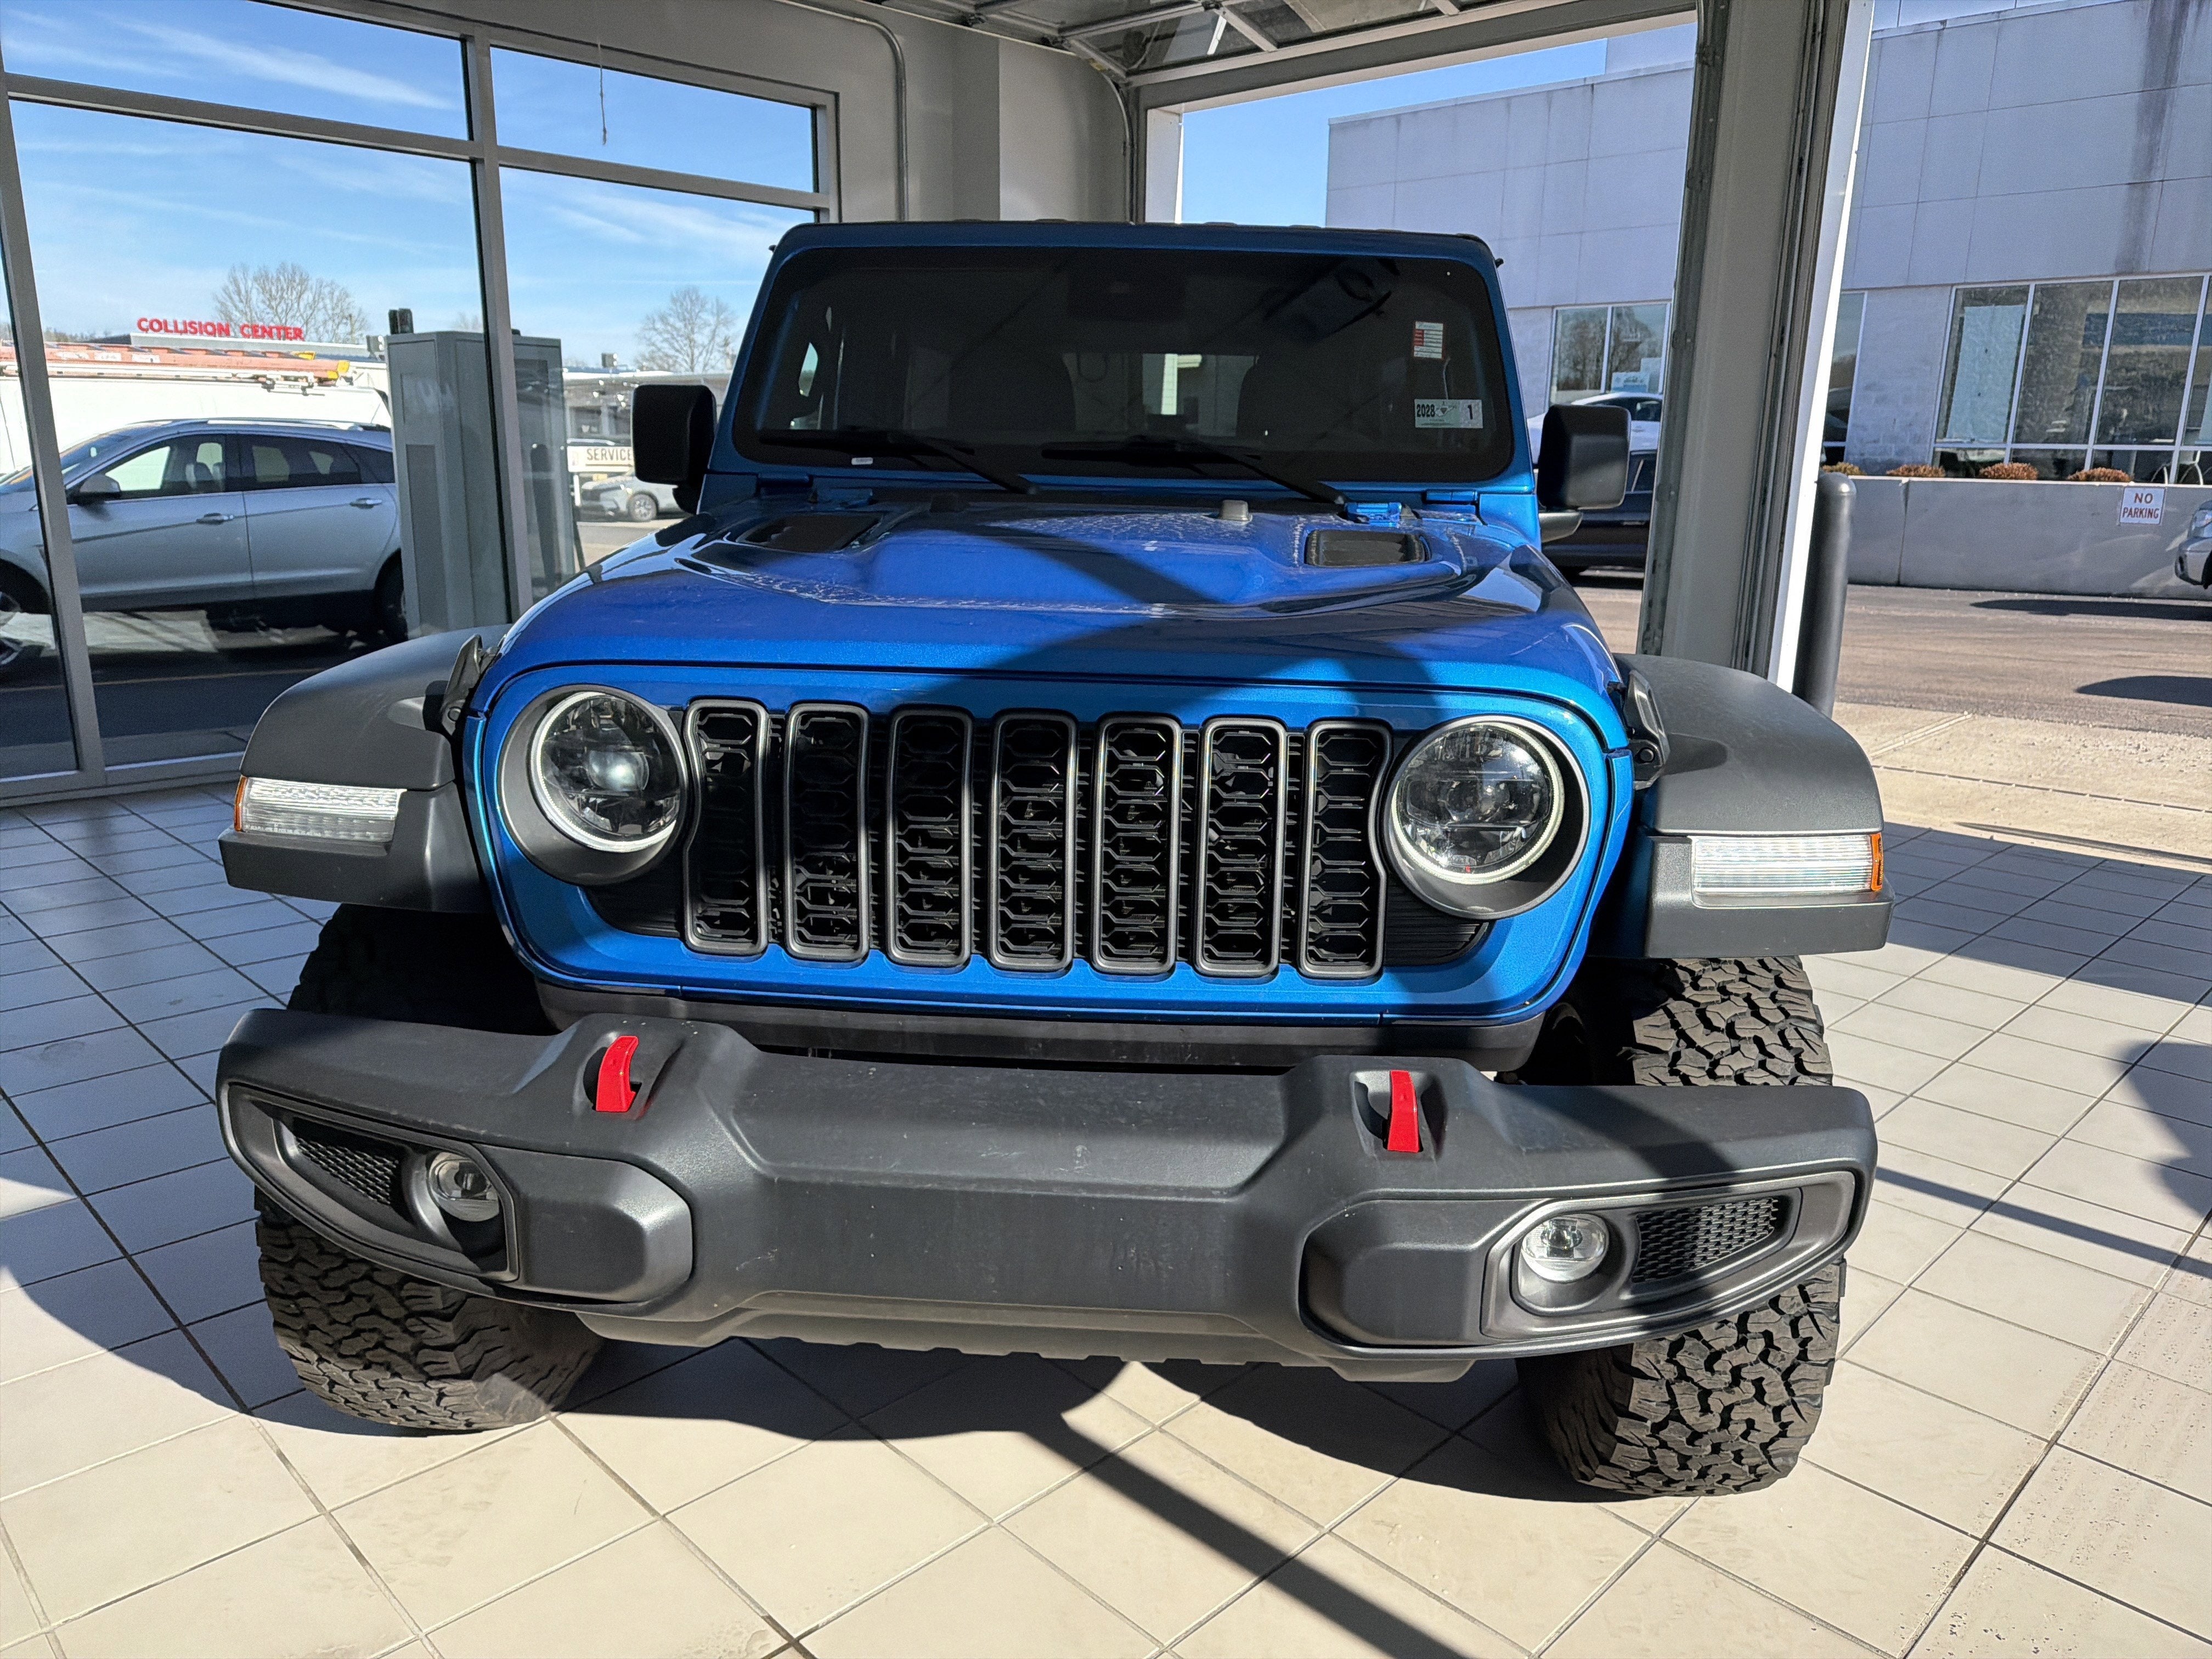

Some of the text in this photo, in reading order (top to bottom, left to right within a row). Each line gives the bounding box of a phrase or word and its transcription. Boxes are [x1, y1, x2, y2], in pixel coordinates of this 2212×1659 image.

[137, 317, 304, 341] COLLISION CENTER
[1417, 404, 1435, 417] 2028
[1467, 404, 1473, 420] 1
[586, 448, 631, 461] SERVICE
[2134, 493, 2153, 504] NO
[2122, 507, 2160, 519] PARKING
